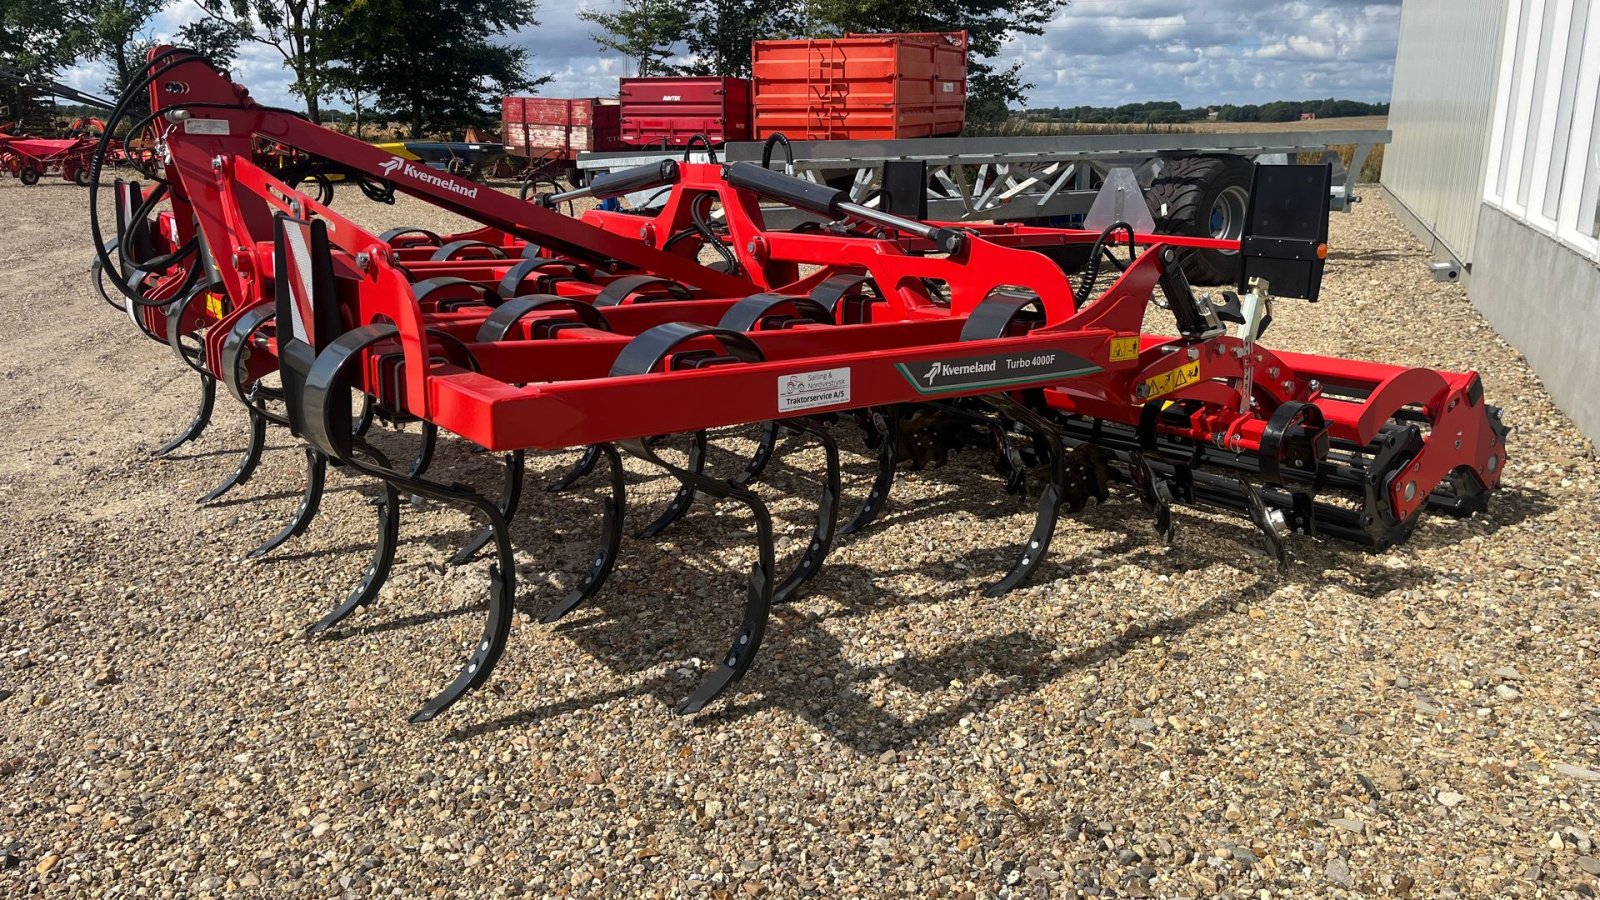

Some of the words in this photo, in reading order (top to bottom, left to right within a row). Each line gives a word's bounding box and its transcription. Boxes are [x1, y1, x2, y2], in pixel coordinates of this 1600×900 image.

[403, 163, 478, 199] Kverneland
[942, 360, 996, 376] Kverneland
[1006, 358, 1031, 370] Turbo
[1031, 354, 1056, 367] 4000F
[807, 373, 828, 382] Salling
[828, 371, 833, 379] &
[786, 392, 833, 405] Traktorservice
[833, 390, 845, 399] A/S
